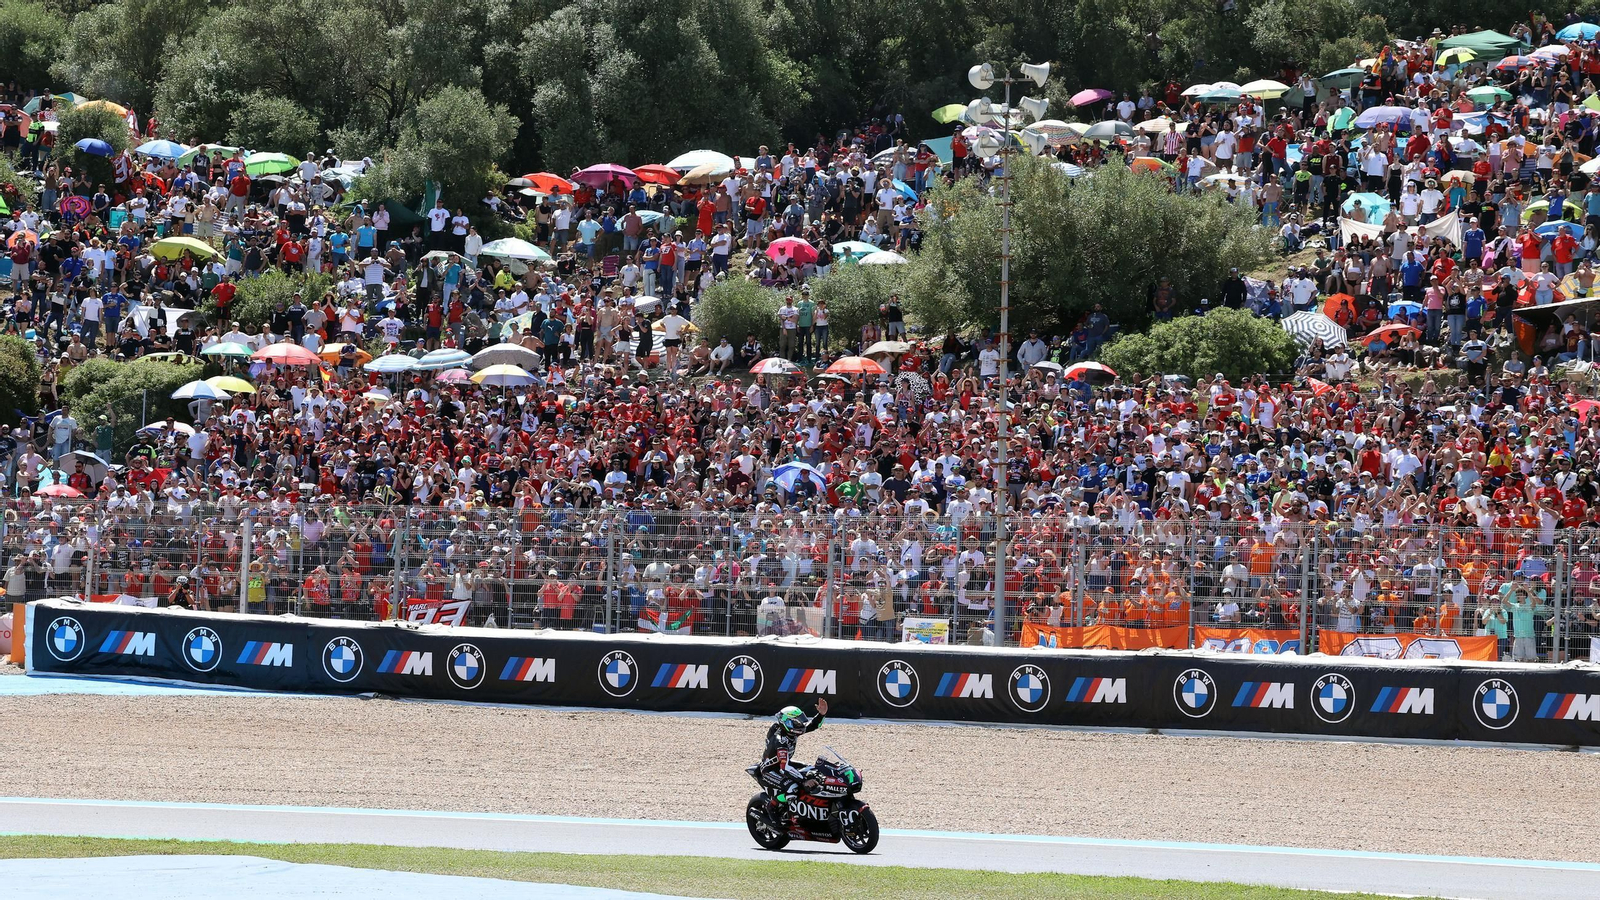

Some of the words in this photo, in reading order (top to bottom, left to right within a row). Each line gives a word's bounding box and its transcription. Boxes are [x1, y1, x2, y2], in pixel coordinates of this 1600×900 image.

[52, 619, 79, 632] BMW
[188, 629, 217, 642] BMW
[329, 638, 358, 652] BMW
[453, 646, 481, 660] BMW
[604, 652, 633, 666] BMW
[729, 657, 758, 671] BMW
[884, 662, 914, 676] BMW
[1015, 666, 1045, 681] BMW
[1181, 671, 1212, 686] BMW
[1318, 676, 1350, 690] BMW
[1480, 682, 1513, 696] BMW
